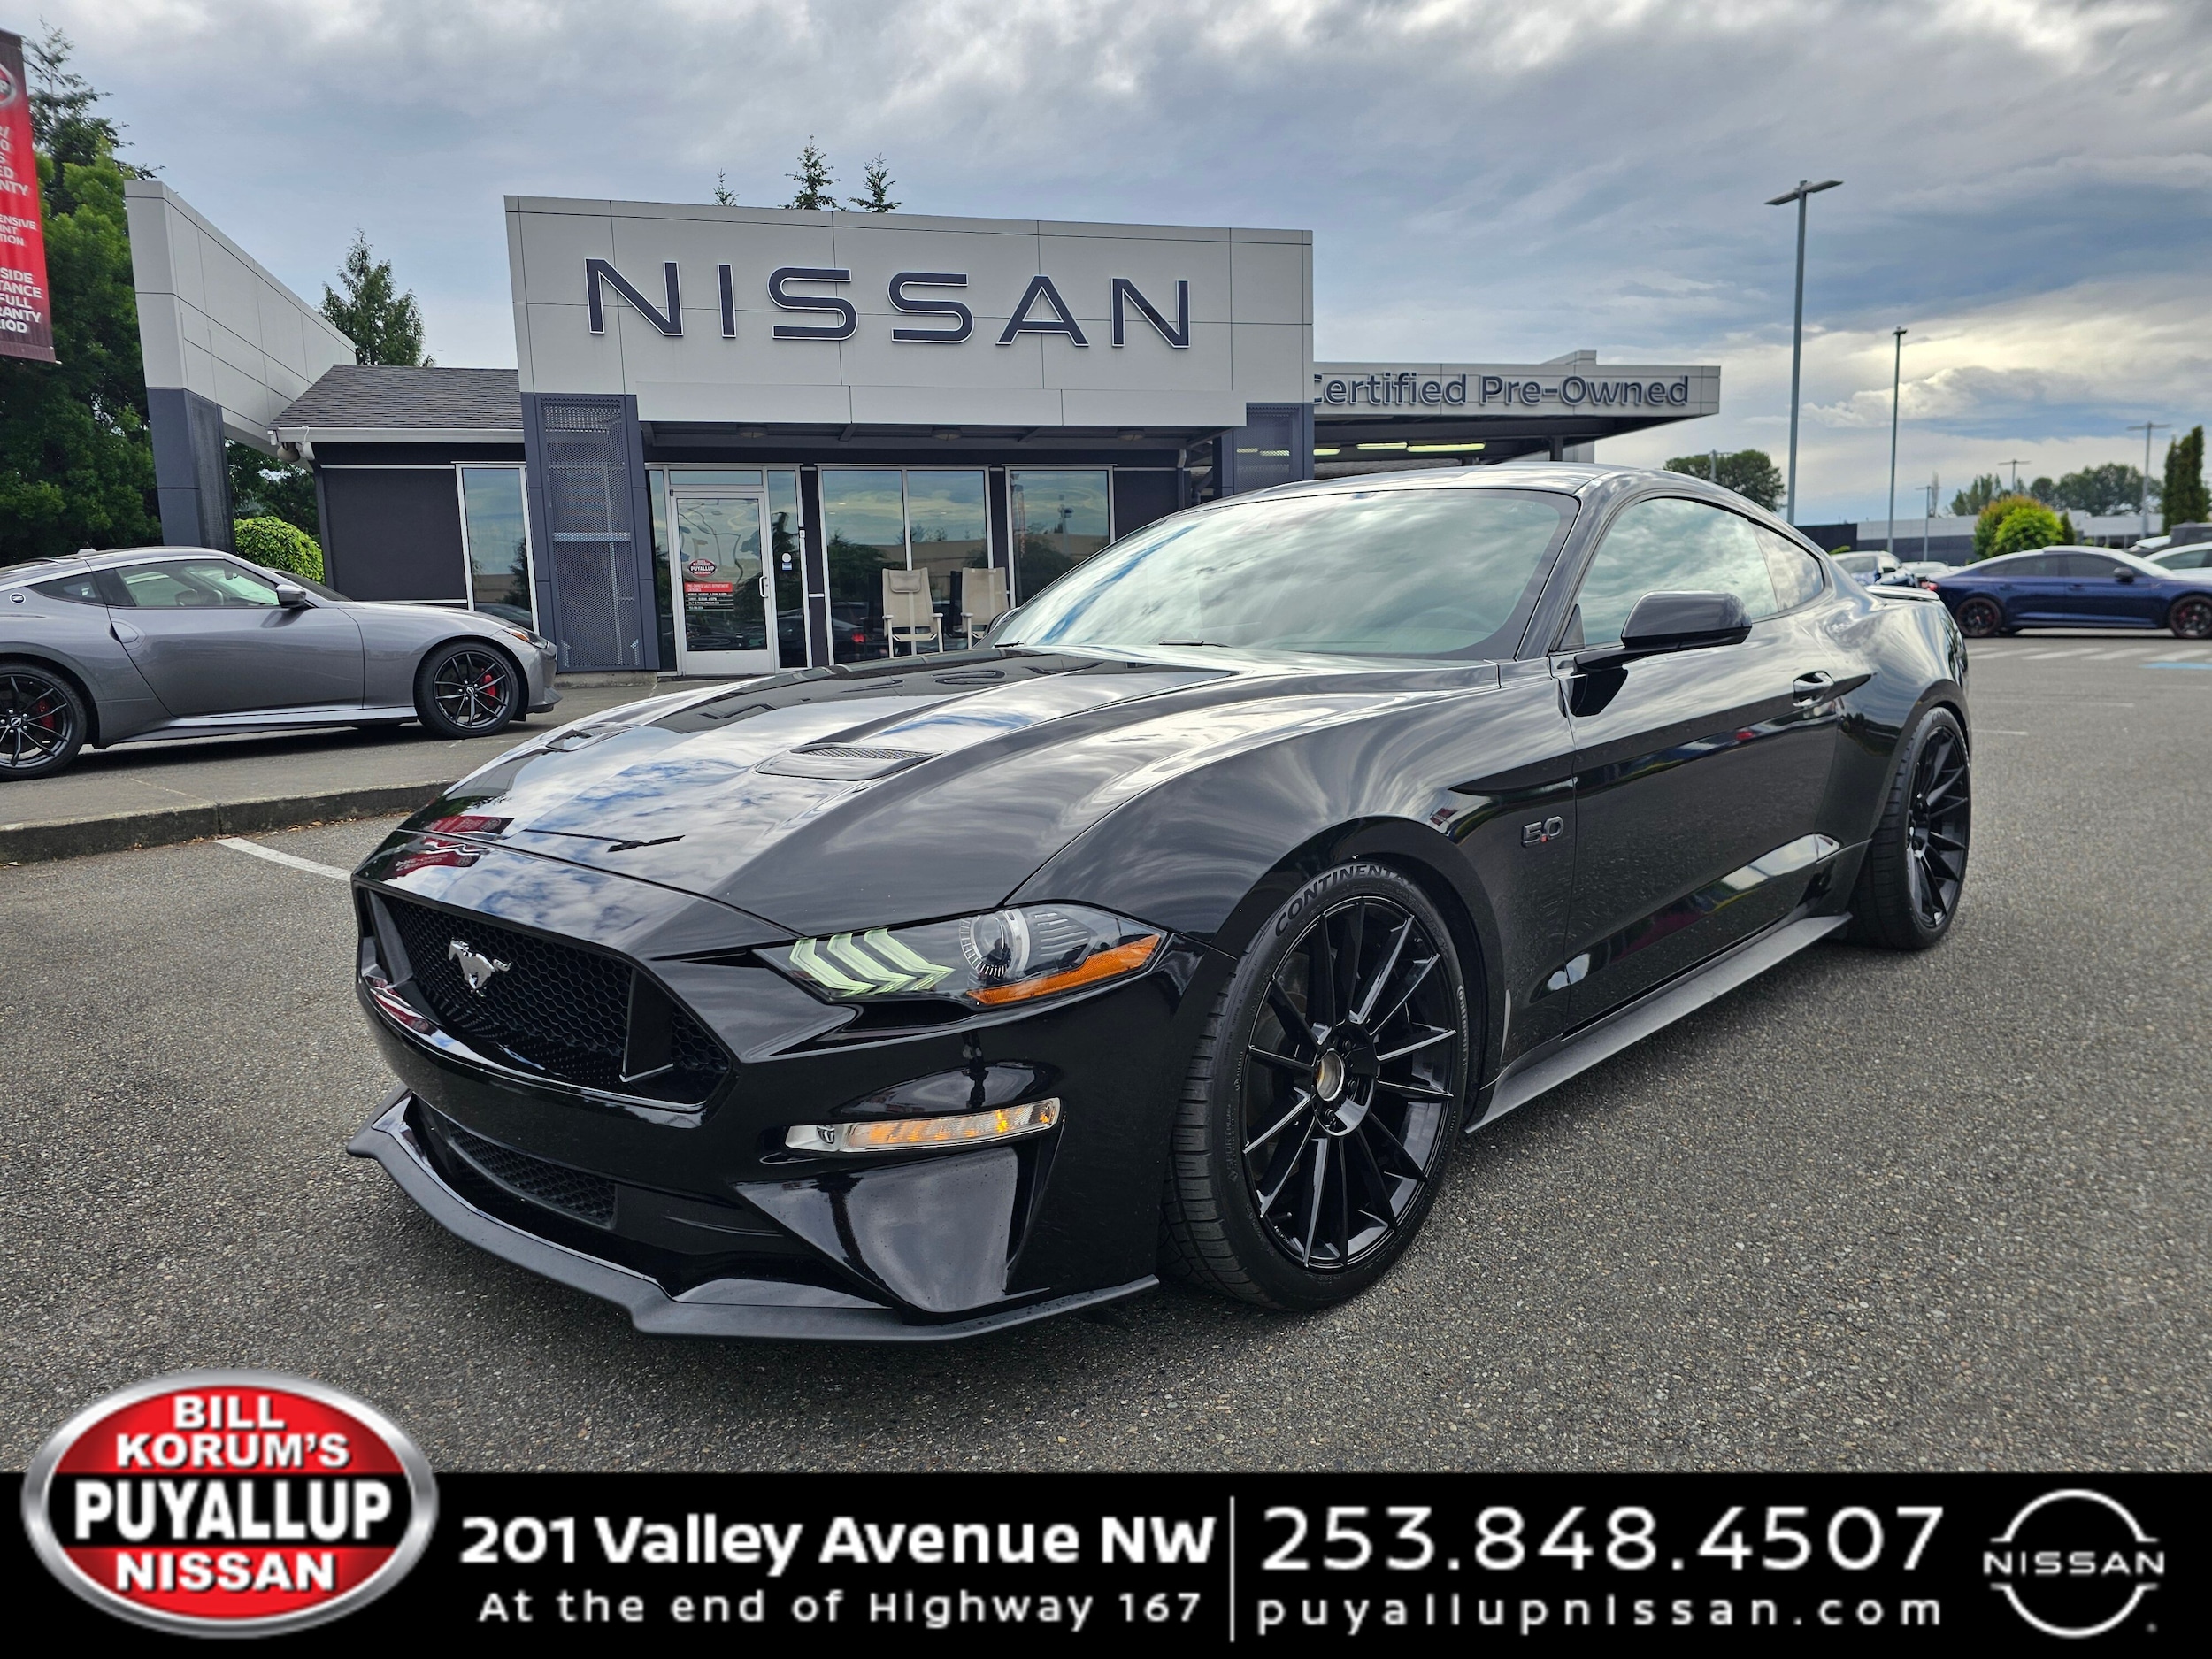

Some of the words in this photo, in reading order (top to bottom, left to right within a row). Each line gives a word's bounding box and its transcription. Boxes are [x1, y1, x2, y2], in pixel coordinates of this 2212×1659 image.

[584, 257, 1191, 349] NISSAN
[0, 319, 27, 334] IOD
[1479, 375, 1689, 407] Pre-Owned
[1523, 816, 1564, 847] 5.0
